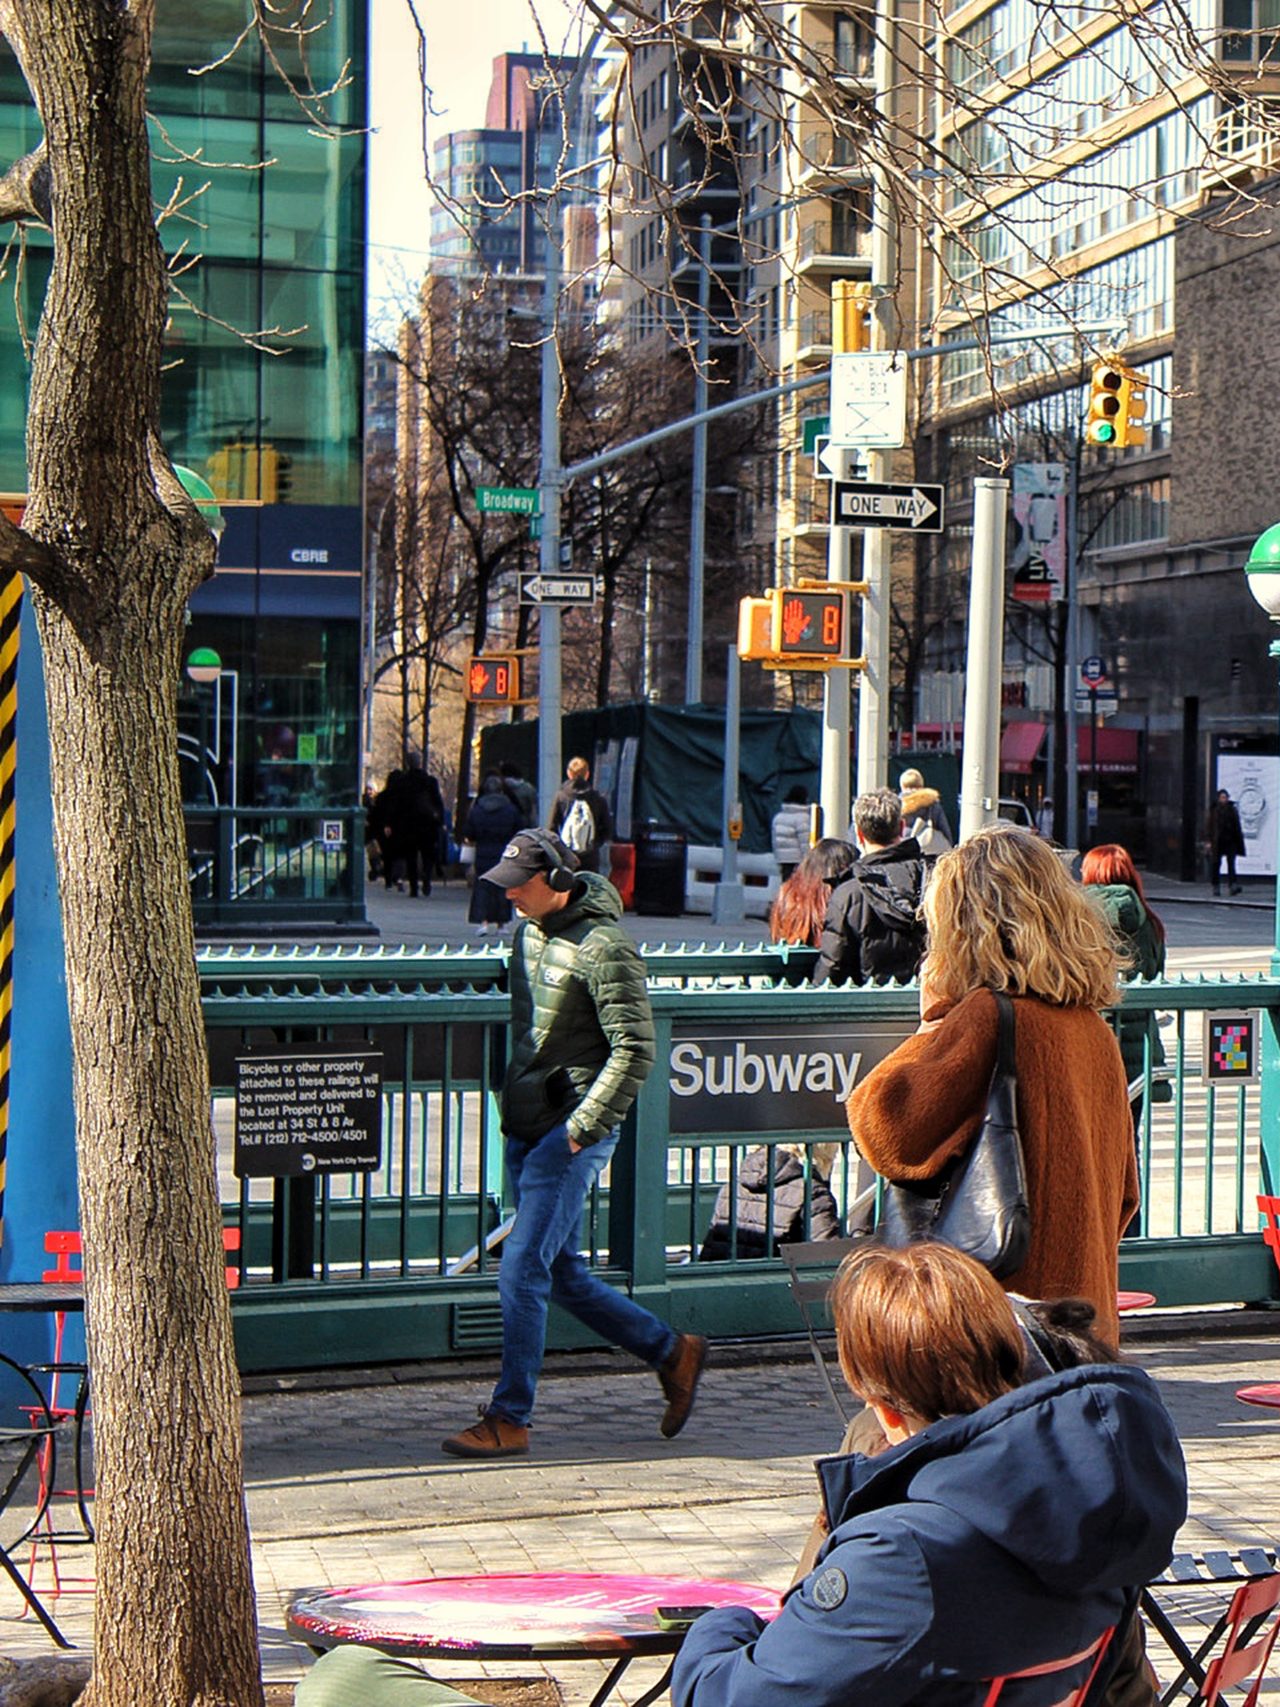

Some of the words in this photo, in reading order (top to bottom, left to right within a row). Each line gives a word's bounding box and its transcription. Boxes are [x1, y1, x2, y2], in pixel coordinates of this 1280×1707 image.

[482, 491, 535, 513] Broadway
[850, 496, 882, 514] ONE
[895, 498, 928, 517] WAY
[291, 548, 329, 563] CBRE
[531, 583, 554, 595] ONE
[563, 583, 586, 596] WAY
[823, 604, 840, 646] 8
[496, 666, 508, 695] 8
[239, 1063, 280, 1076] Bicycles
[282, 1065, 292, 1073] or
[295, 1063, 321, 1073] other
[323, 1061, 364, 1073] property
[669, 1042, 862, 1103] Subway
[239, 1078, 282, 1088] attached
[285, 1078, 295, 1088] to
[298, 1076, 325, 1086] these
[328, 1074, 361, 1087] railings
[363, 1073, 379, 1084] will
[239, 1092, 252, 1103] be
[255, 1091, 296, 1102] removed
[299, 1090, 317, 1101] and
[319, 1088, 363, 1100] delivered
[365, 1088, 376, 1098] to
[239, 1106, 254, 1117] the
[258, 1105, 279, 1116] Lost
[282, 1104, 323, 1116] Property
[326, 1103, 345, 1114] Unit
[239, 1119, 275, 1131] located
[277, 1119, 288, 1130] at
[290, 1118, 303, 1129] 34
[306, 1117, 318, 1128] St
[320, 1117, 329, 1128] &
[332, 1116, 339, 1126] 8
[342, 1116, 355, 1126] Av
[264, 1132, 289, 1145] (212)
[291, 1130, 368, 1143] 712-4500/4501
[344, 1157, 357, 1167] City
[357, 1156, 377, 1164] Transit
